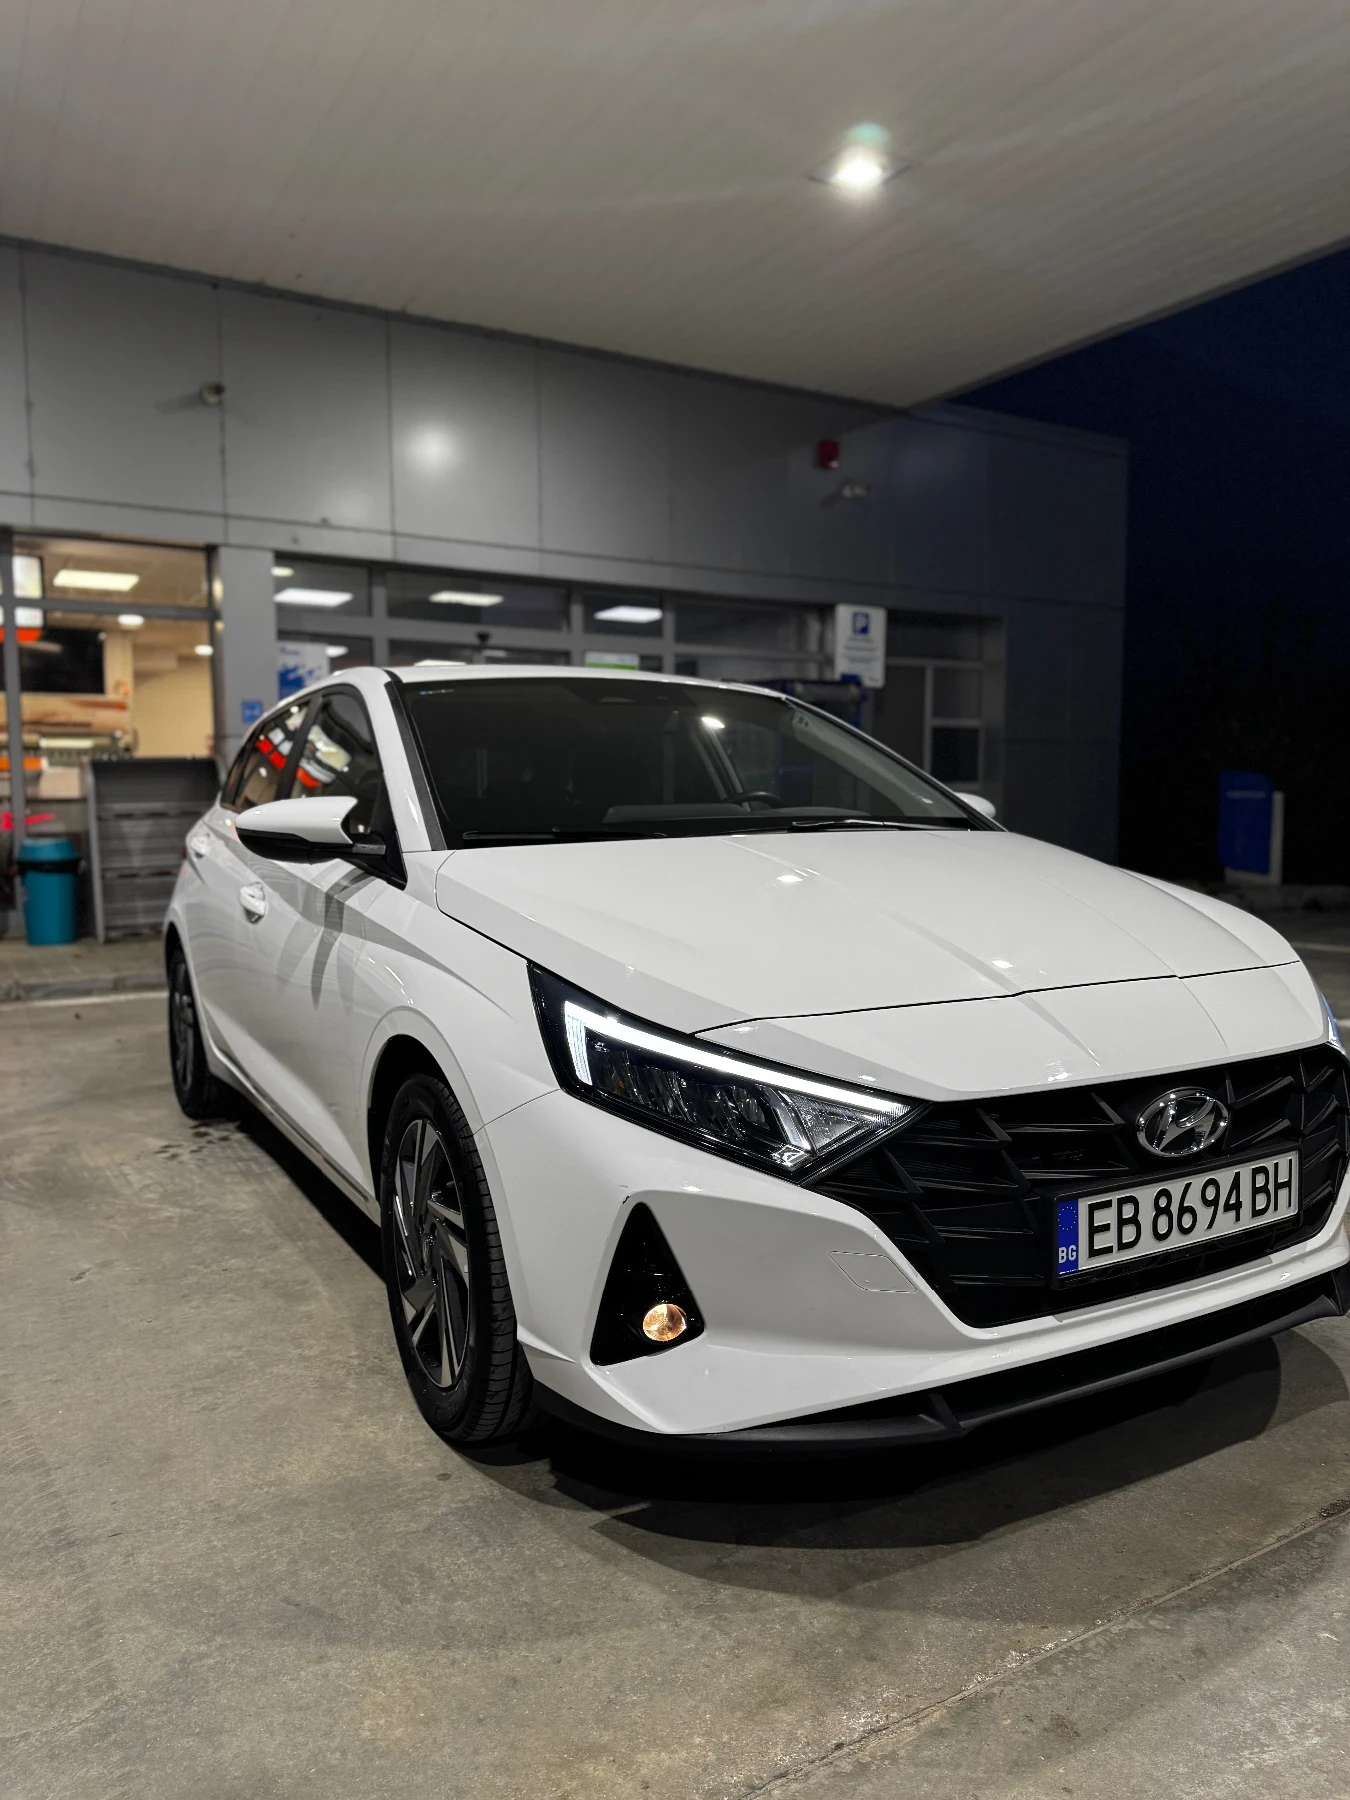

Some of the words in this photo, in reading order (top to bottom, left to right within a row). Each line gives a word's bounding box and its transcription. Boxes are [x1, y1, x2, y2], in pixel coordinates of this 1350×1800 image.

[1087, 1194, 1142, 1259] EB
[1152, 1170, 1243, 1242] 8694
[1251, 1158, 1293, 1219] BH
[1058, 1244, 1077, 1264] BG
